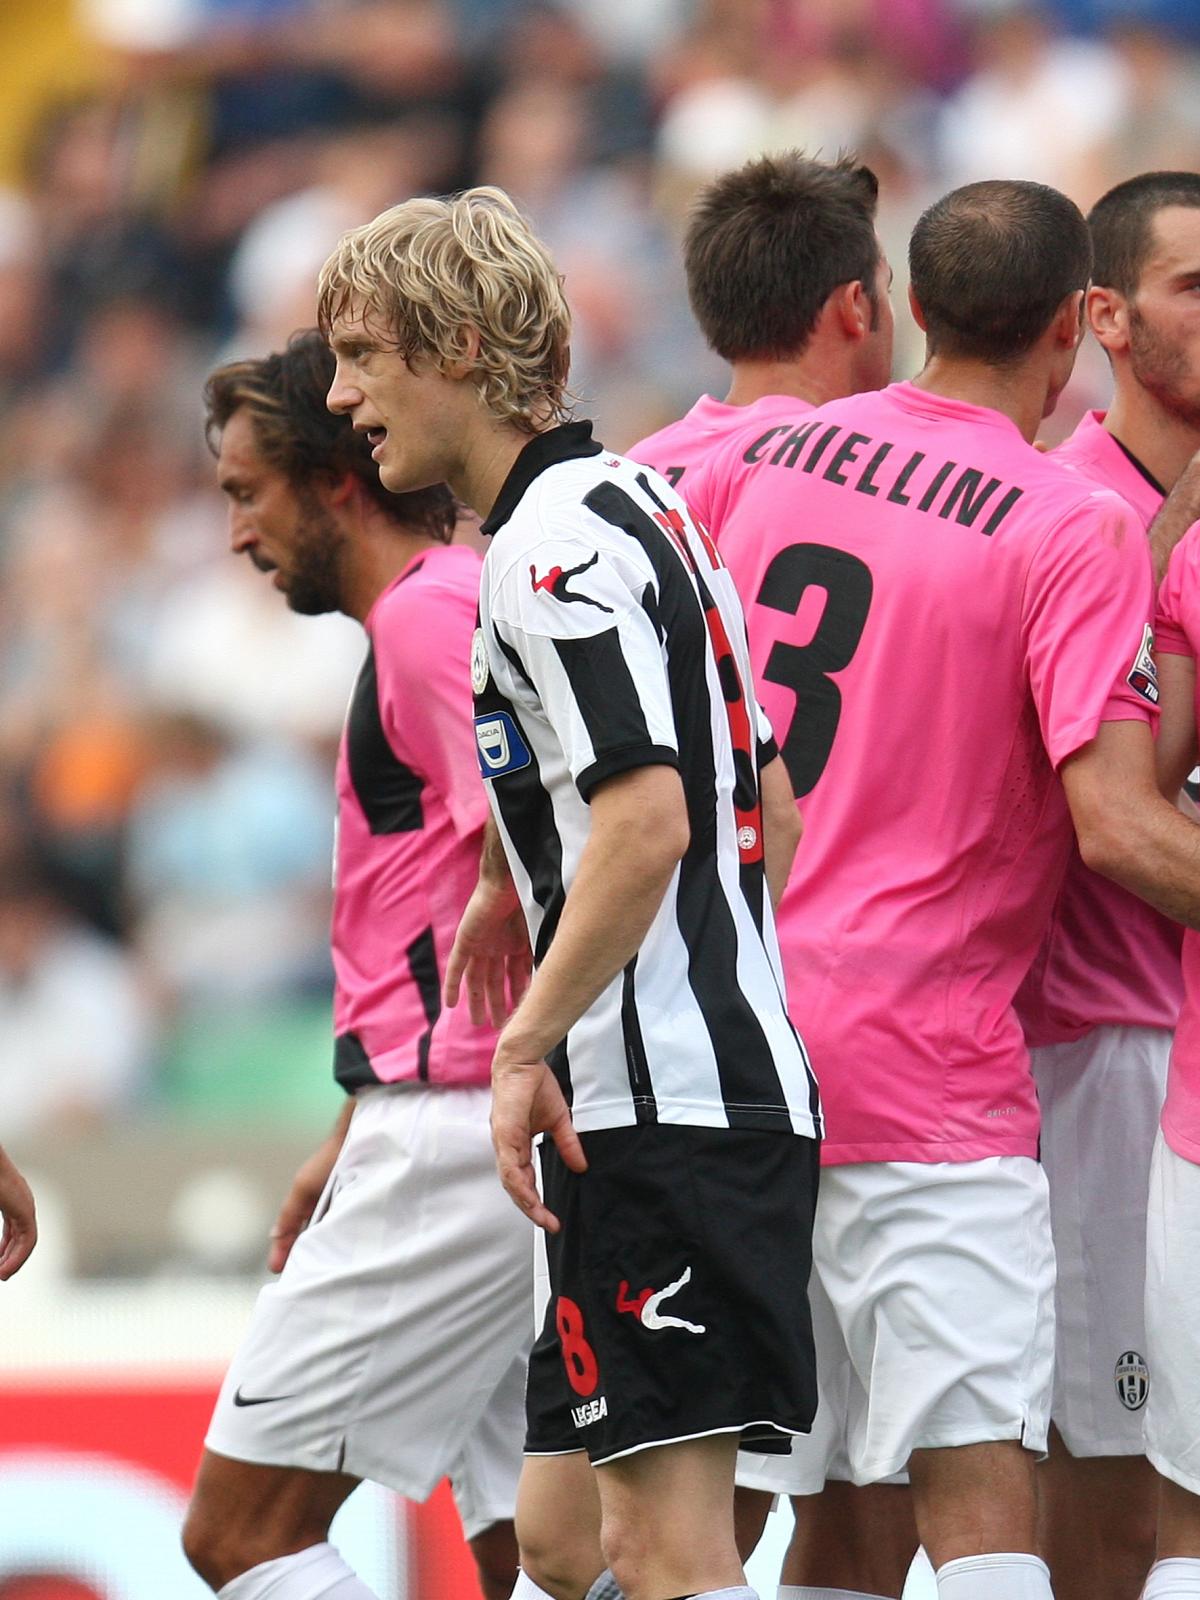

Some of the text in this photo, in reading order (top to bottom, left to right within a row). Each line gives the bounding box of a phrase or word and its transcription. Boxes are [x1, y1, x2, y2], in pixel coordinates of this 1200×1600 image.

[743, 421, 1024, 537] CHIELLINI
[756, 542, 873, 800] 3
[556, 1296, 598, 1397] 8
[571, 1396, 608, 1428] LEGEA
